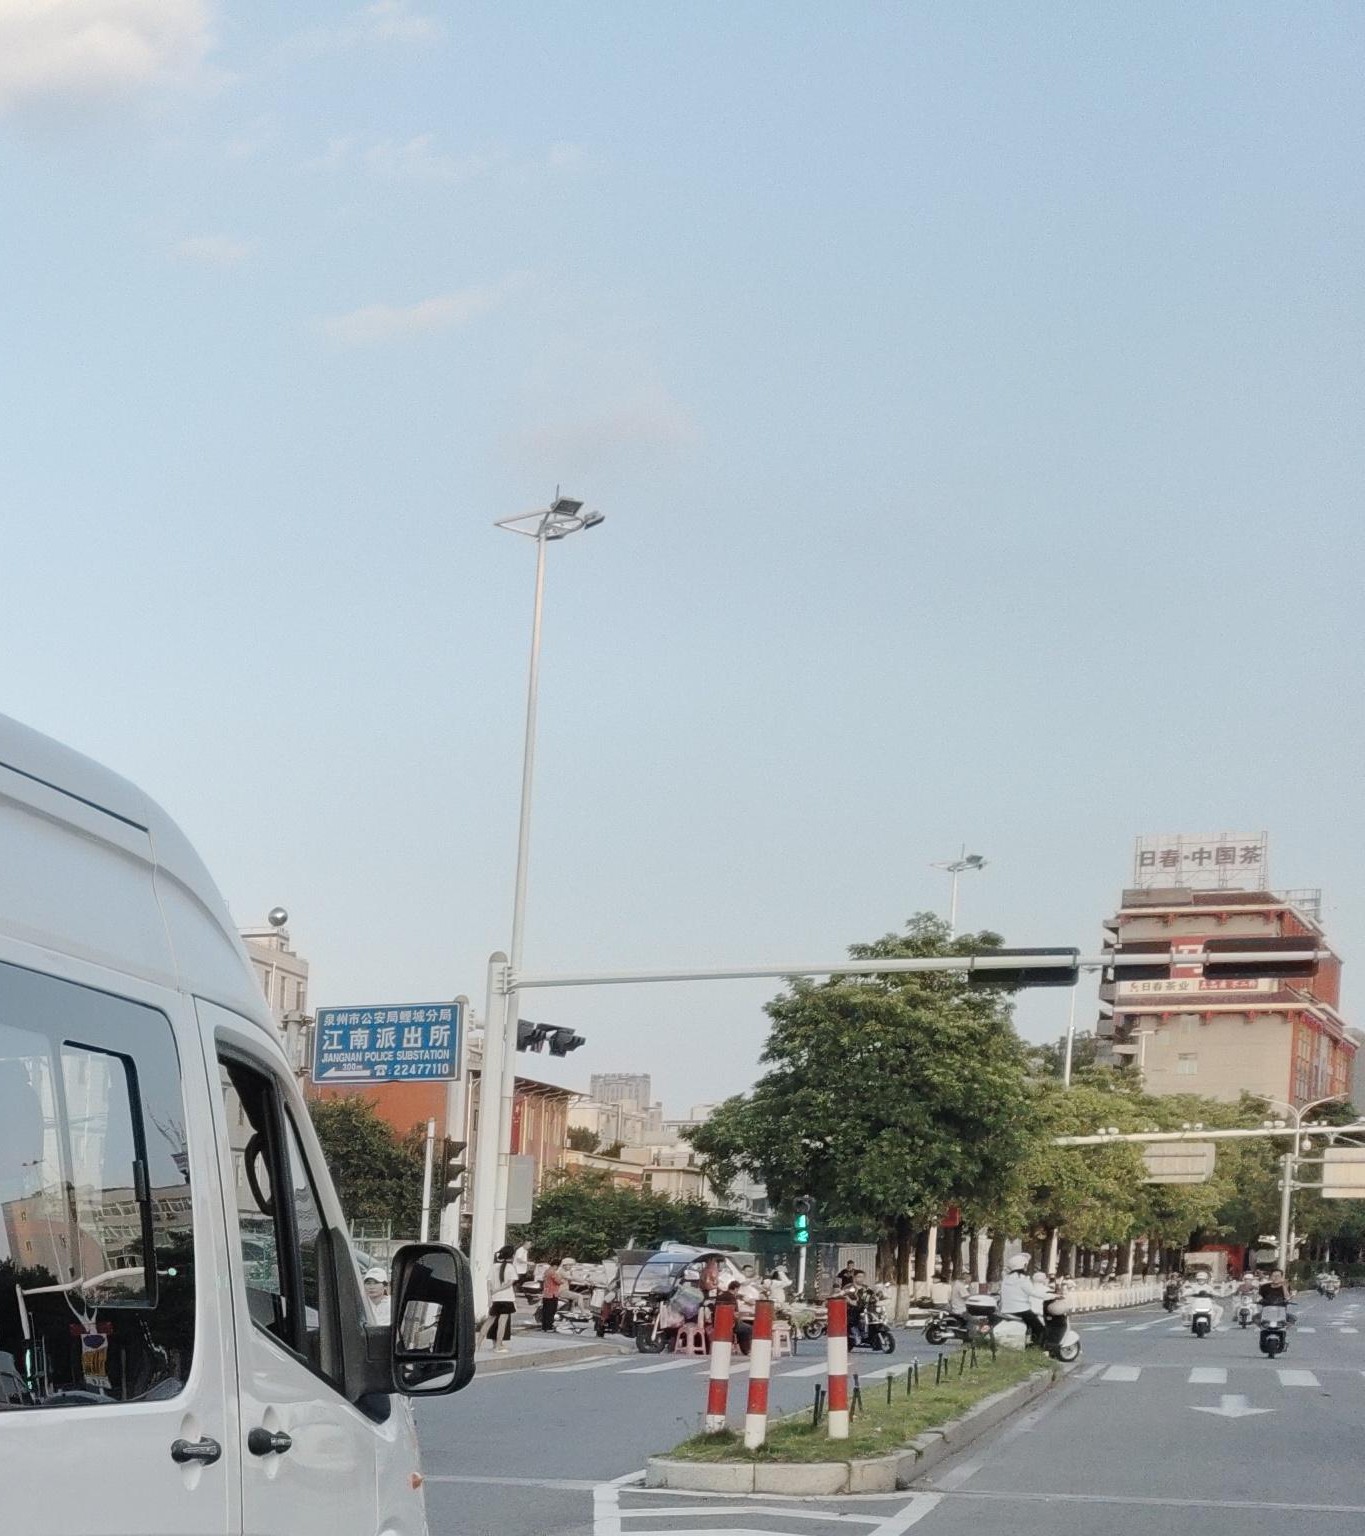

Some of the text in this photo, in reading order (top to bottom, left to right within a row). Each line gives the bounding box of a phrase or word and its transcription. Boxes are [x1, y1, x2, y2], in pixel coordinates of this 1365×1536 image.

[324, 1008, 452, 1026] 泉州市公安局鲤城分局
[322, 1024, 451, 1050] 江南派出所
[321, 1049, 450, 1063] JIANGNAN POLICE SUBSTATION
